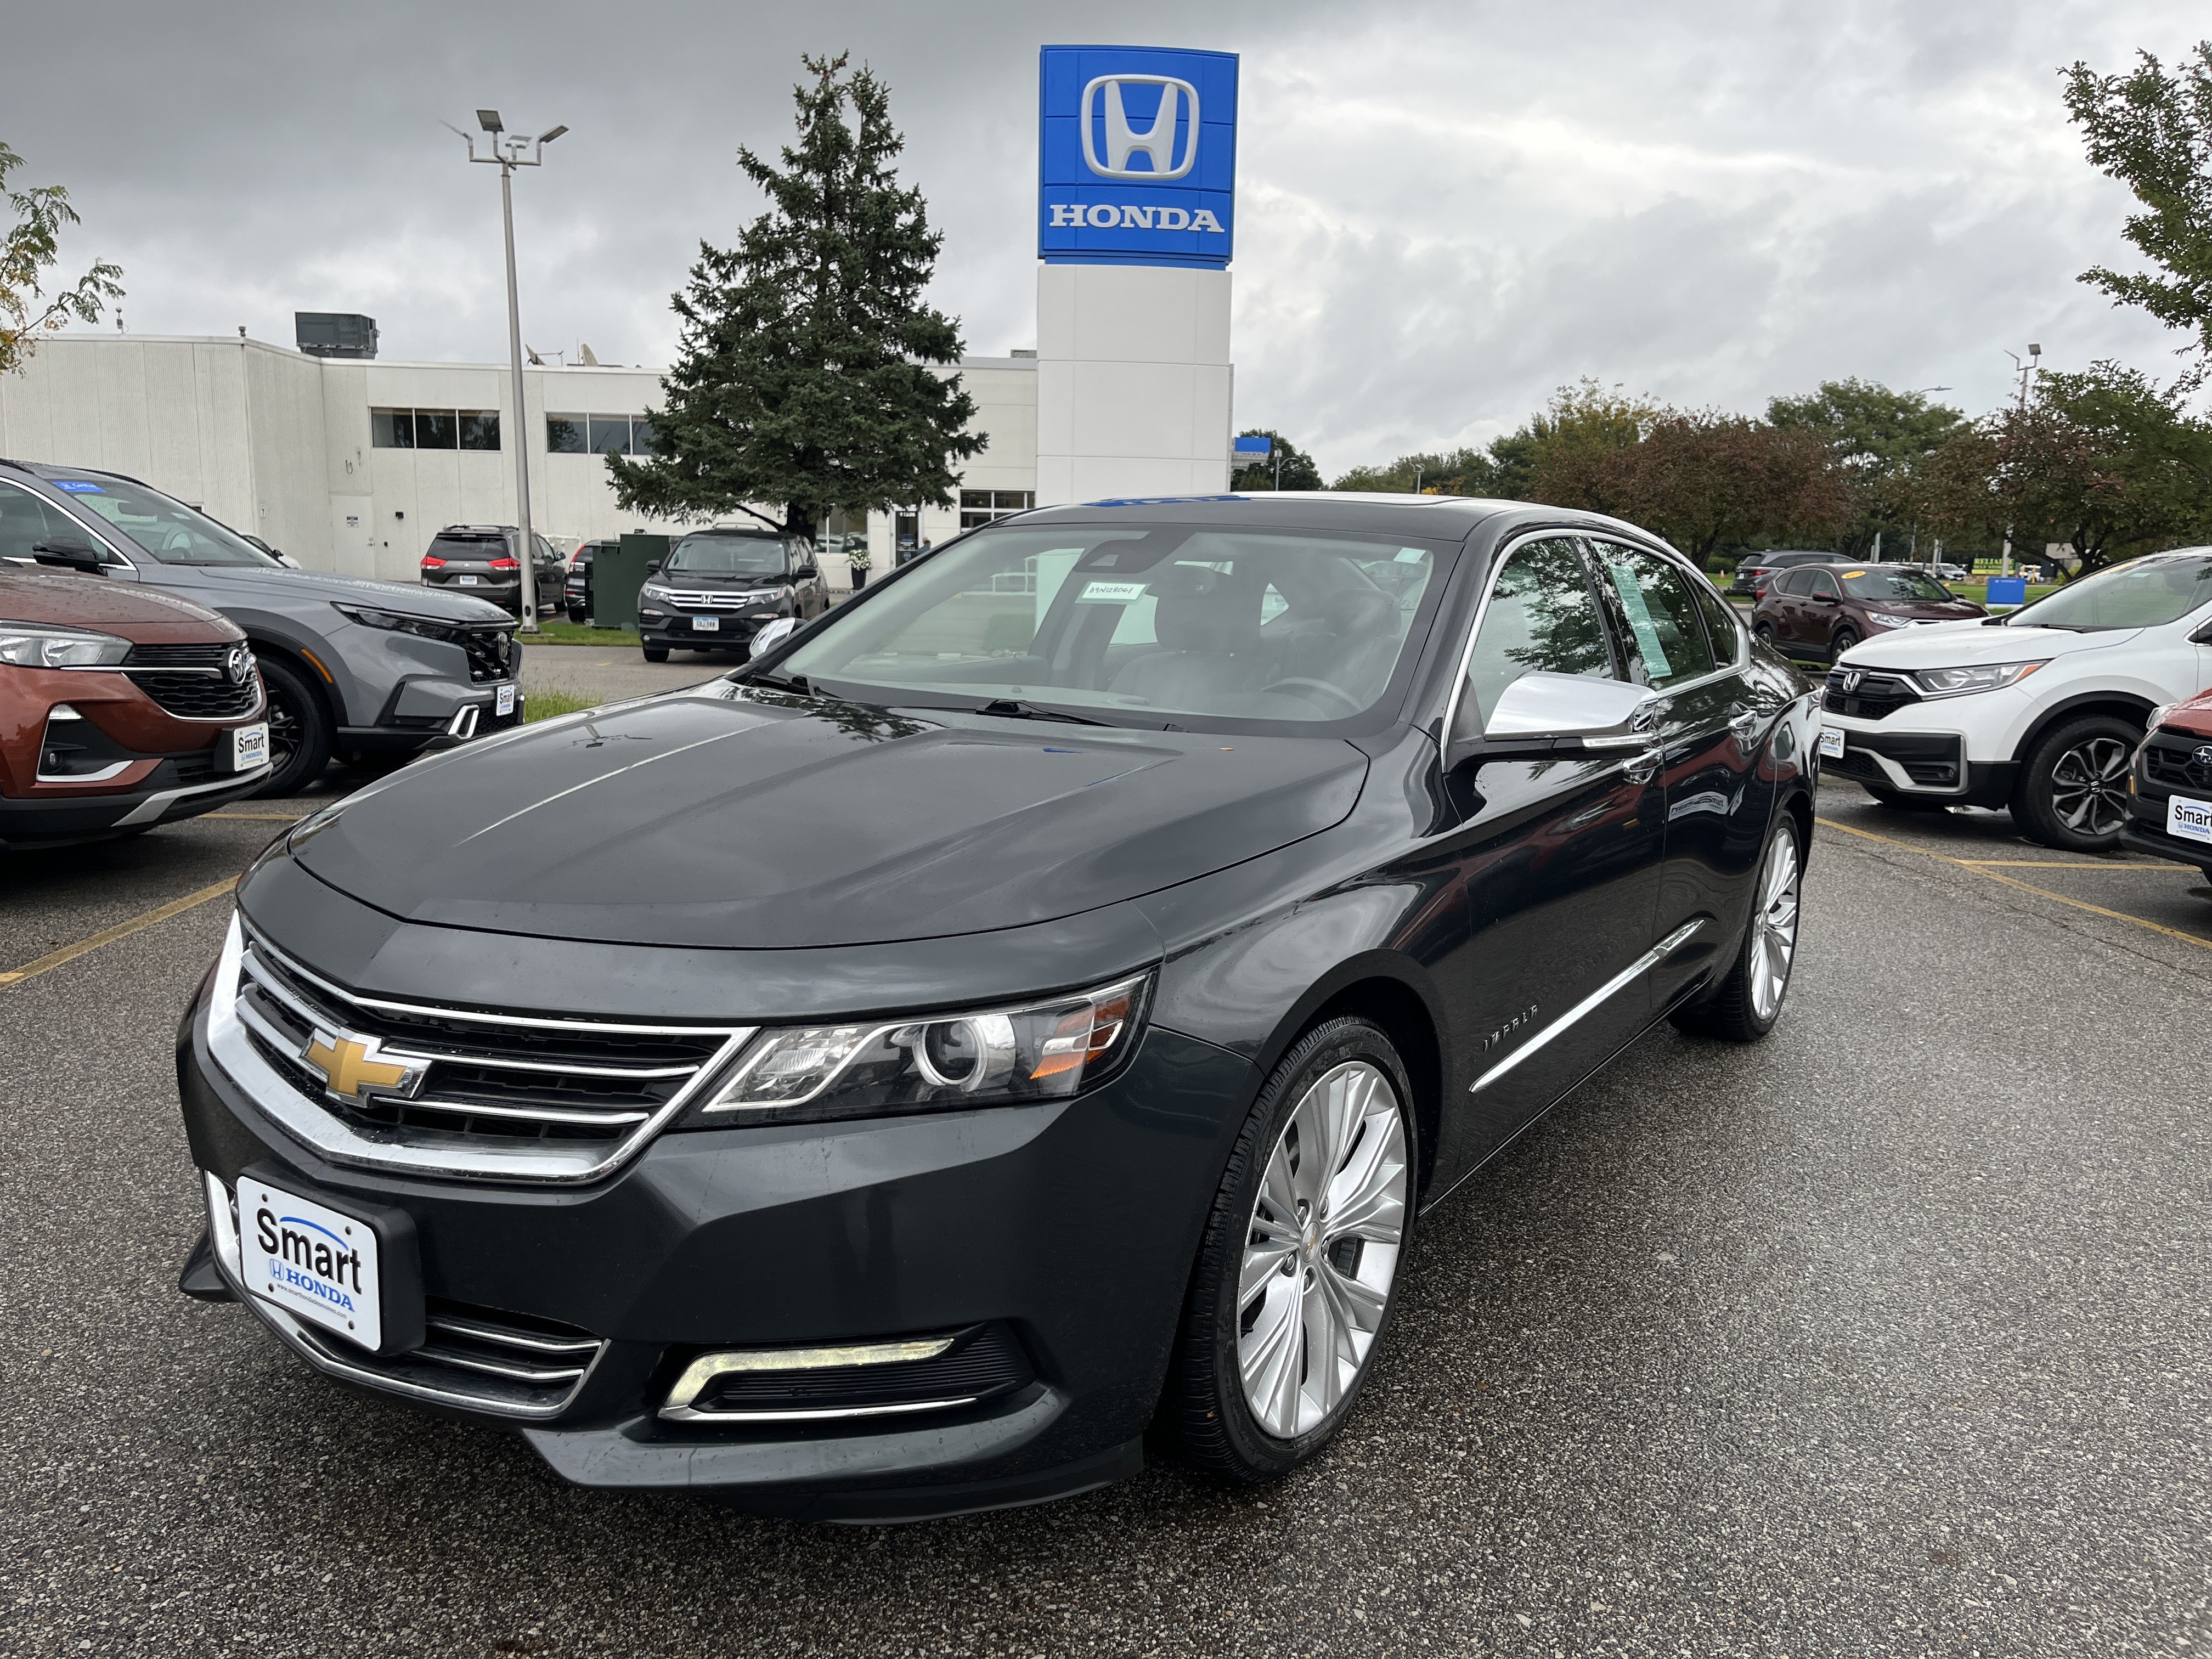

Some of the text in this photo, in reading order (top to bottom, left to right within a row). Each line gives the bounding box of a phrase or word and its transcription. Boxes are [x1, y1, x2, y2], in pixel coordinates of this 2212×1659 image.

[1049, 204, 1226, 233] HONDA
[238, 732, 264, 753] Smart
[246, 750, 263, 760] HONDA
[2184, 823, 2210, 834] HONDA
[1483, 1005, 1538, 1053] IMPALA
[257, 1207, 362, 1295] Smart
[286, 1268, 356, 1313] HONDA
